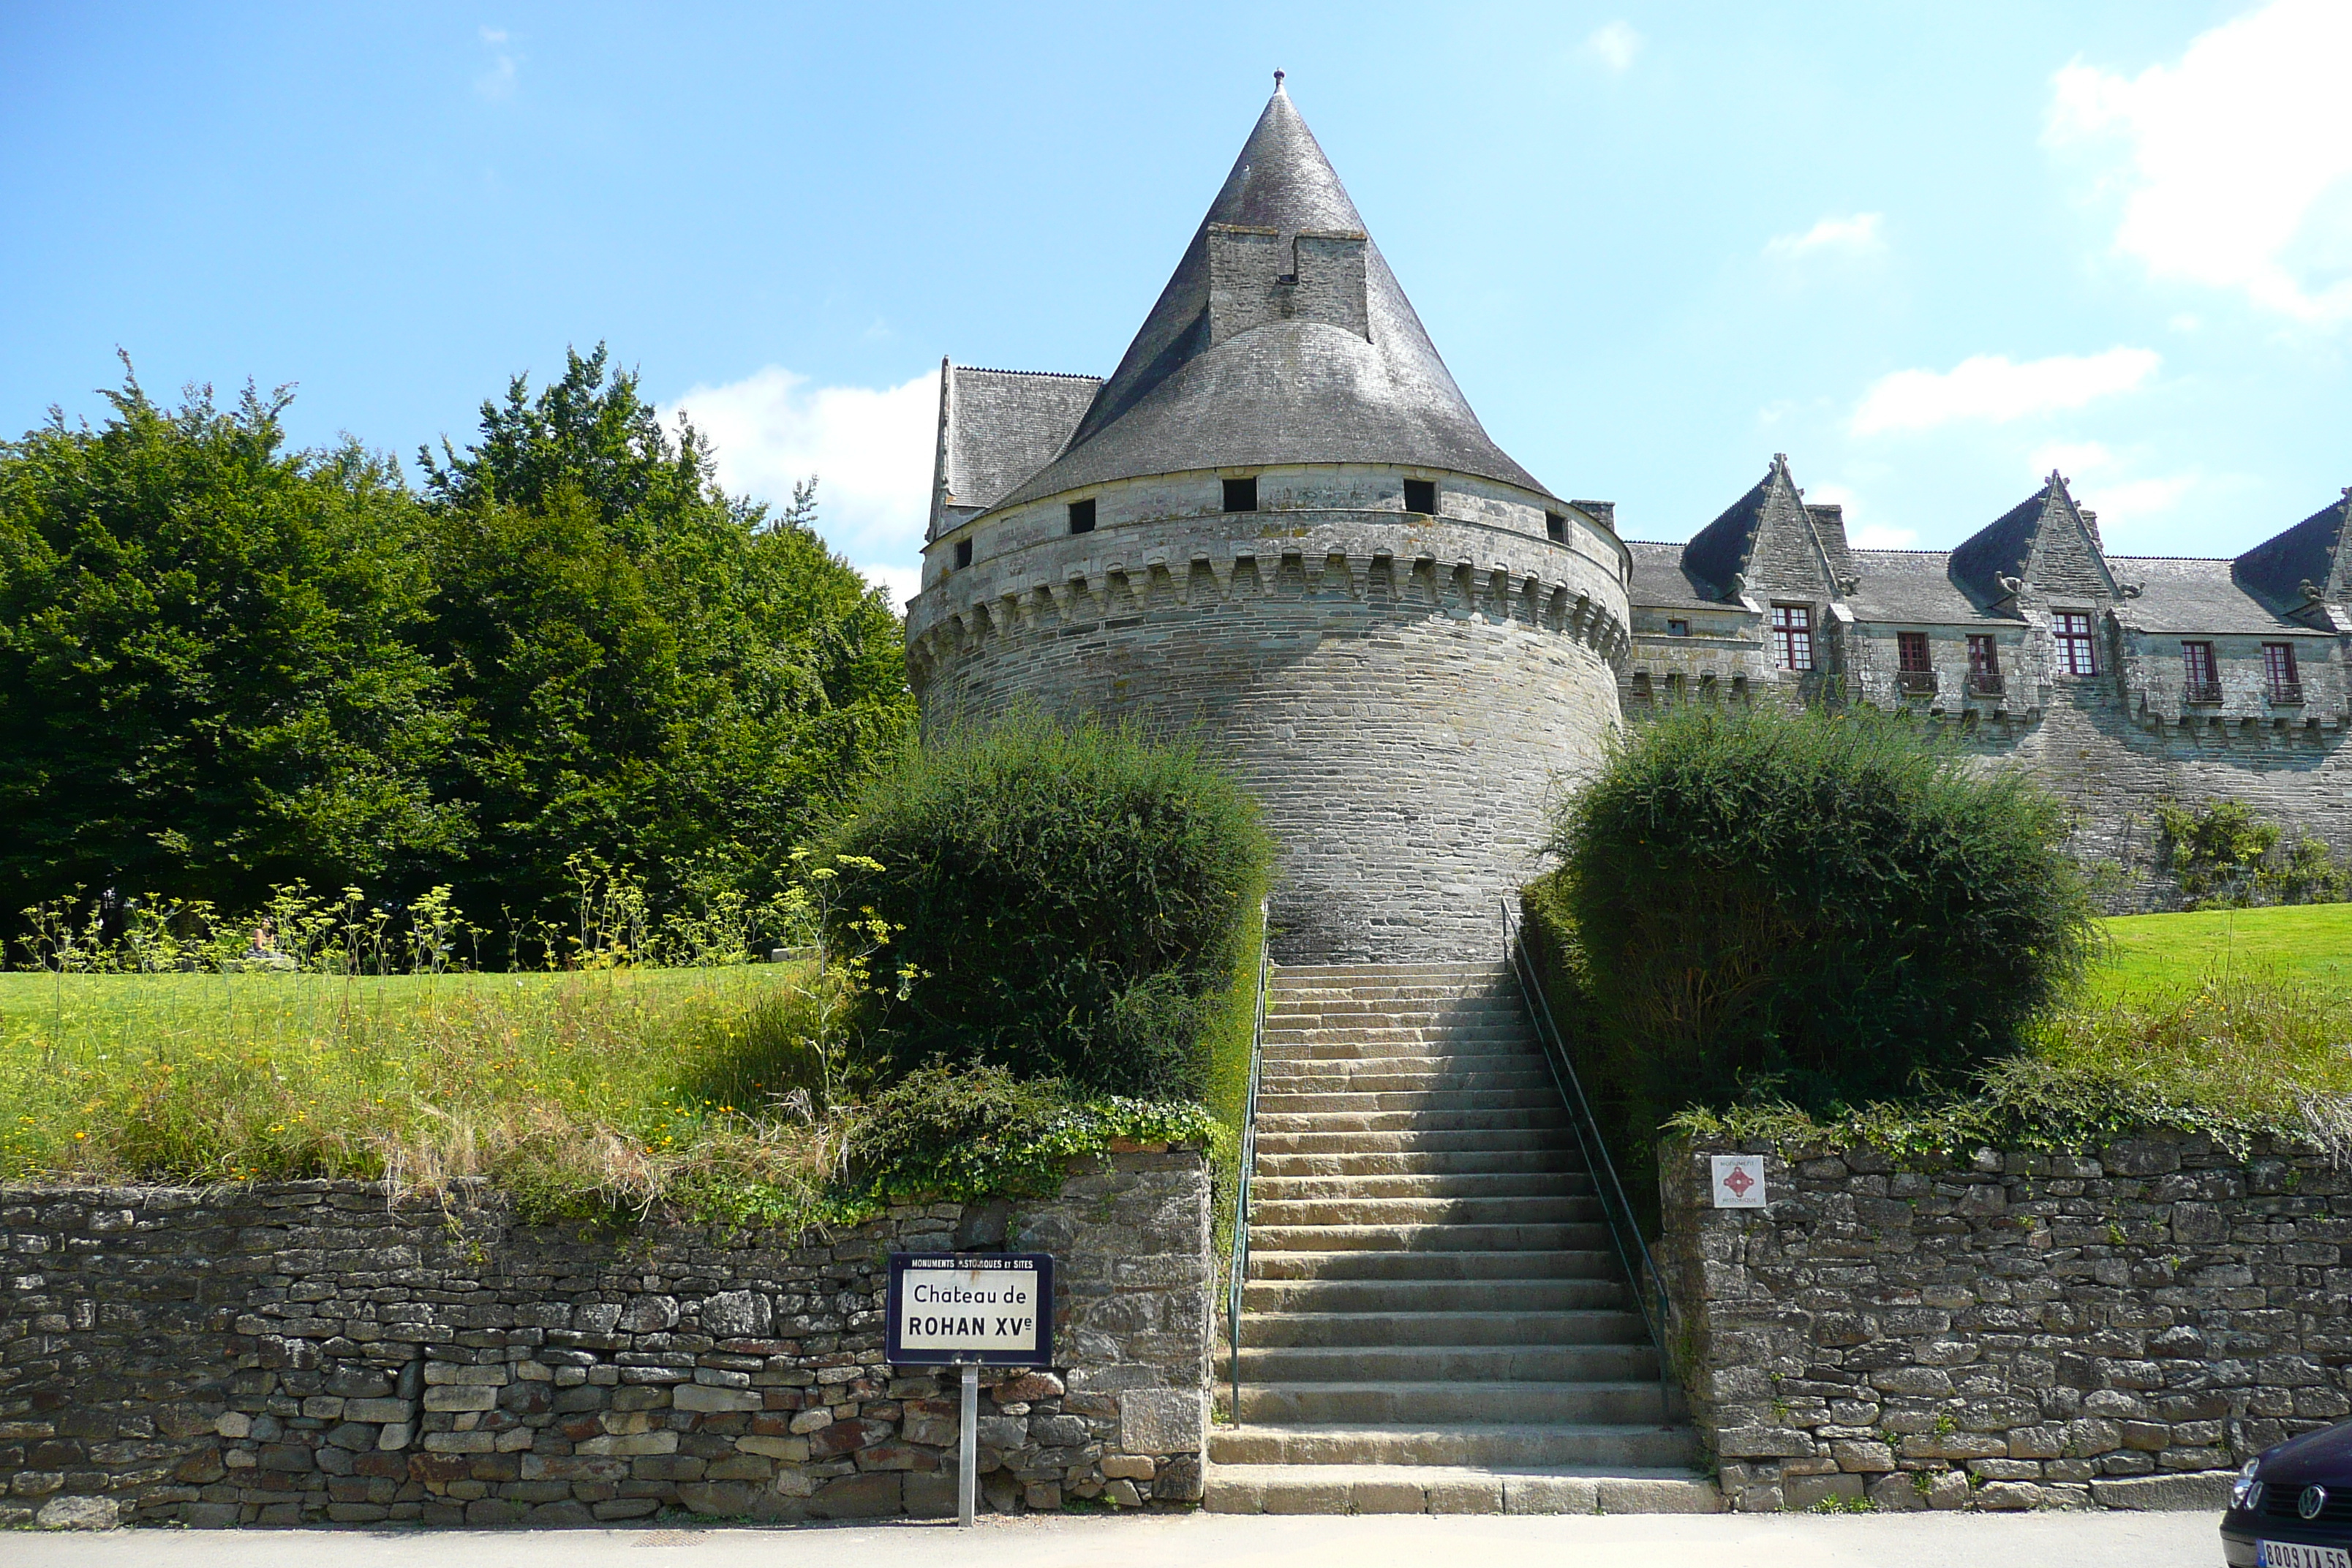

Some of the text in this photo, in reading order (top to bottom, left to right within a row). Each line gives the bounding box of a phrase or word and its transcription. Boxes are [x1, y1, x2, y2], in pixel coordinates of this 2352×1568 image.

[912, 1259, 954, 1268] MONUMENTS
[1004, 1261, 1011, 1269] ET
[1014, 1260, 1033, 1269] SITES
[914, 1284, 1027, 1304] Château de
[909, 1316, 985, 1335] ROHAN
[2266, 1544, 2346, 1568] 8009 XA 56
